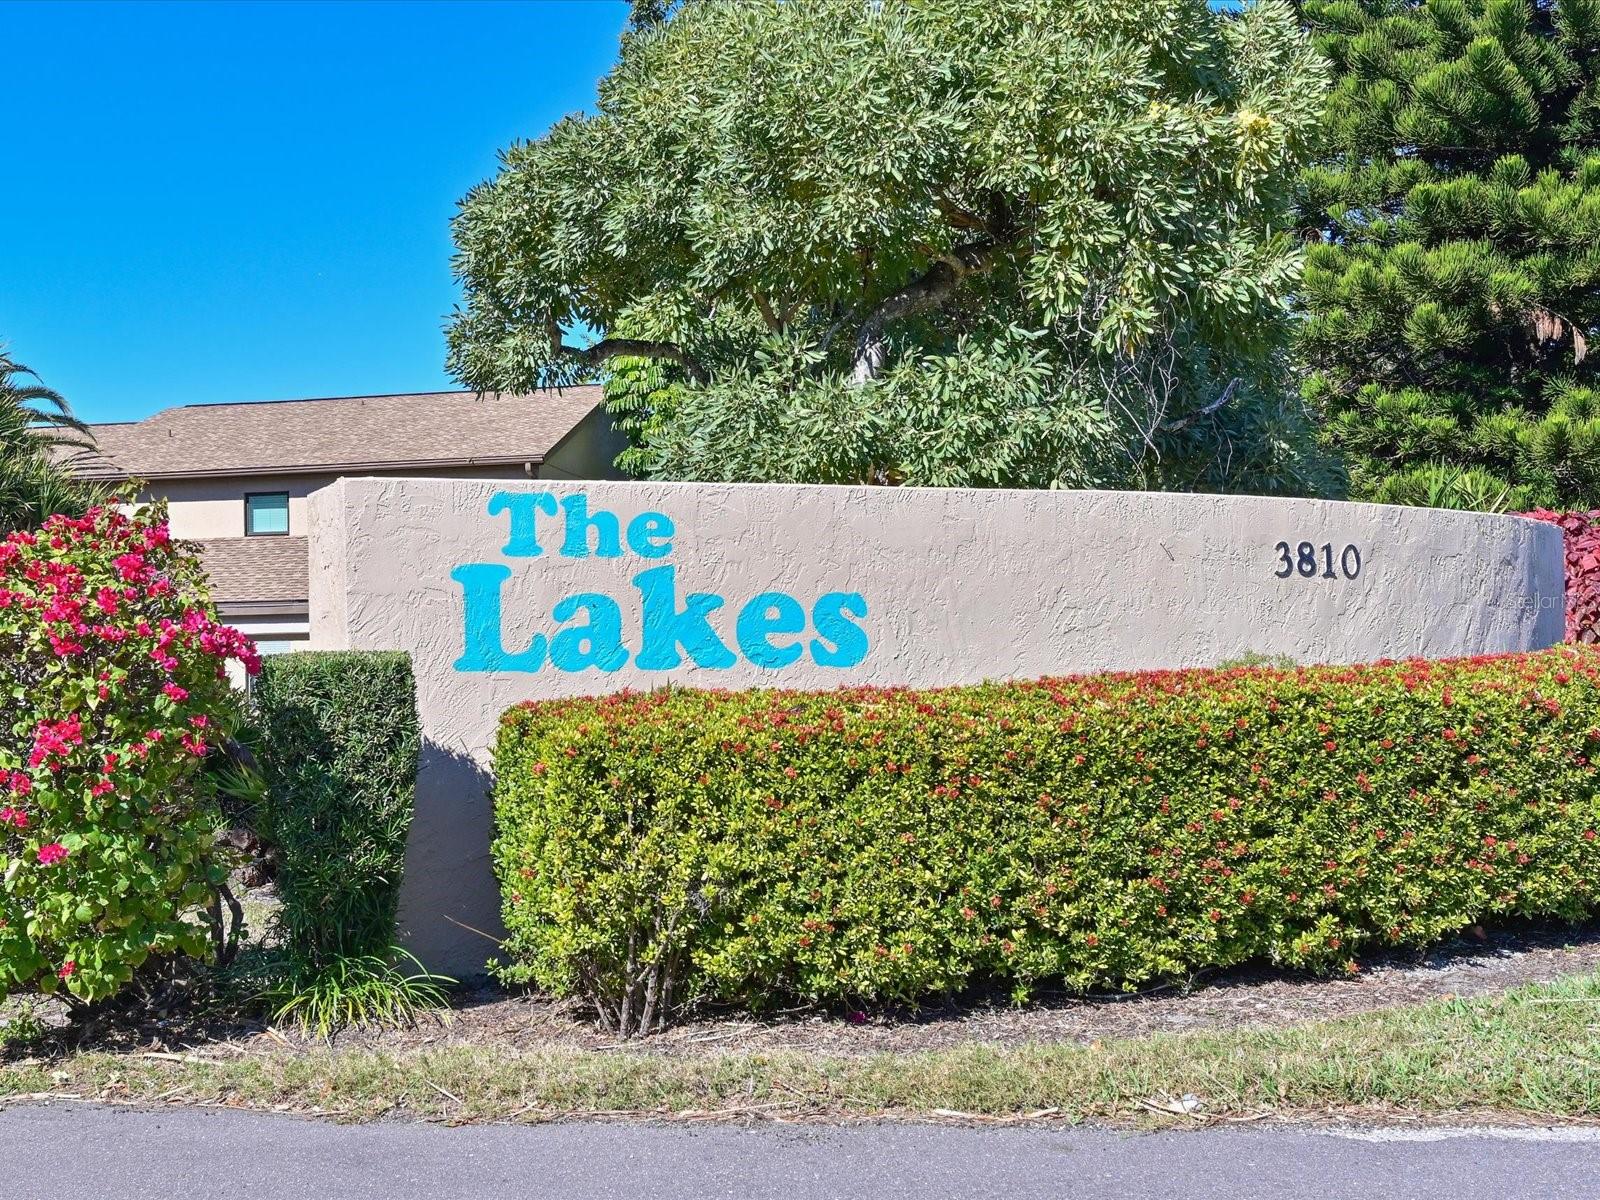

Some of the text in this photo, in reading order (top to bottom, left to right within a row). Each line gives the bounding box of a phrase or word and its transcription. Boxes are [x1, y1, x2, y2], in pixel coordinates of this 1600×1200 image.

[487, 491, 676, 559] The
[1275, 541, 1361, 580] 3810
[451, 563, 869, 674] Lakes
